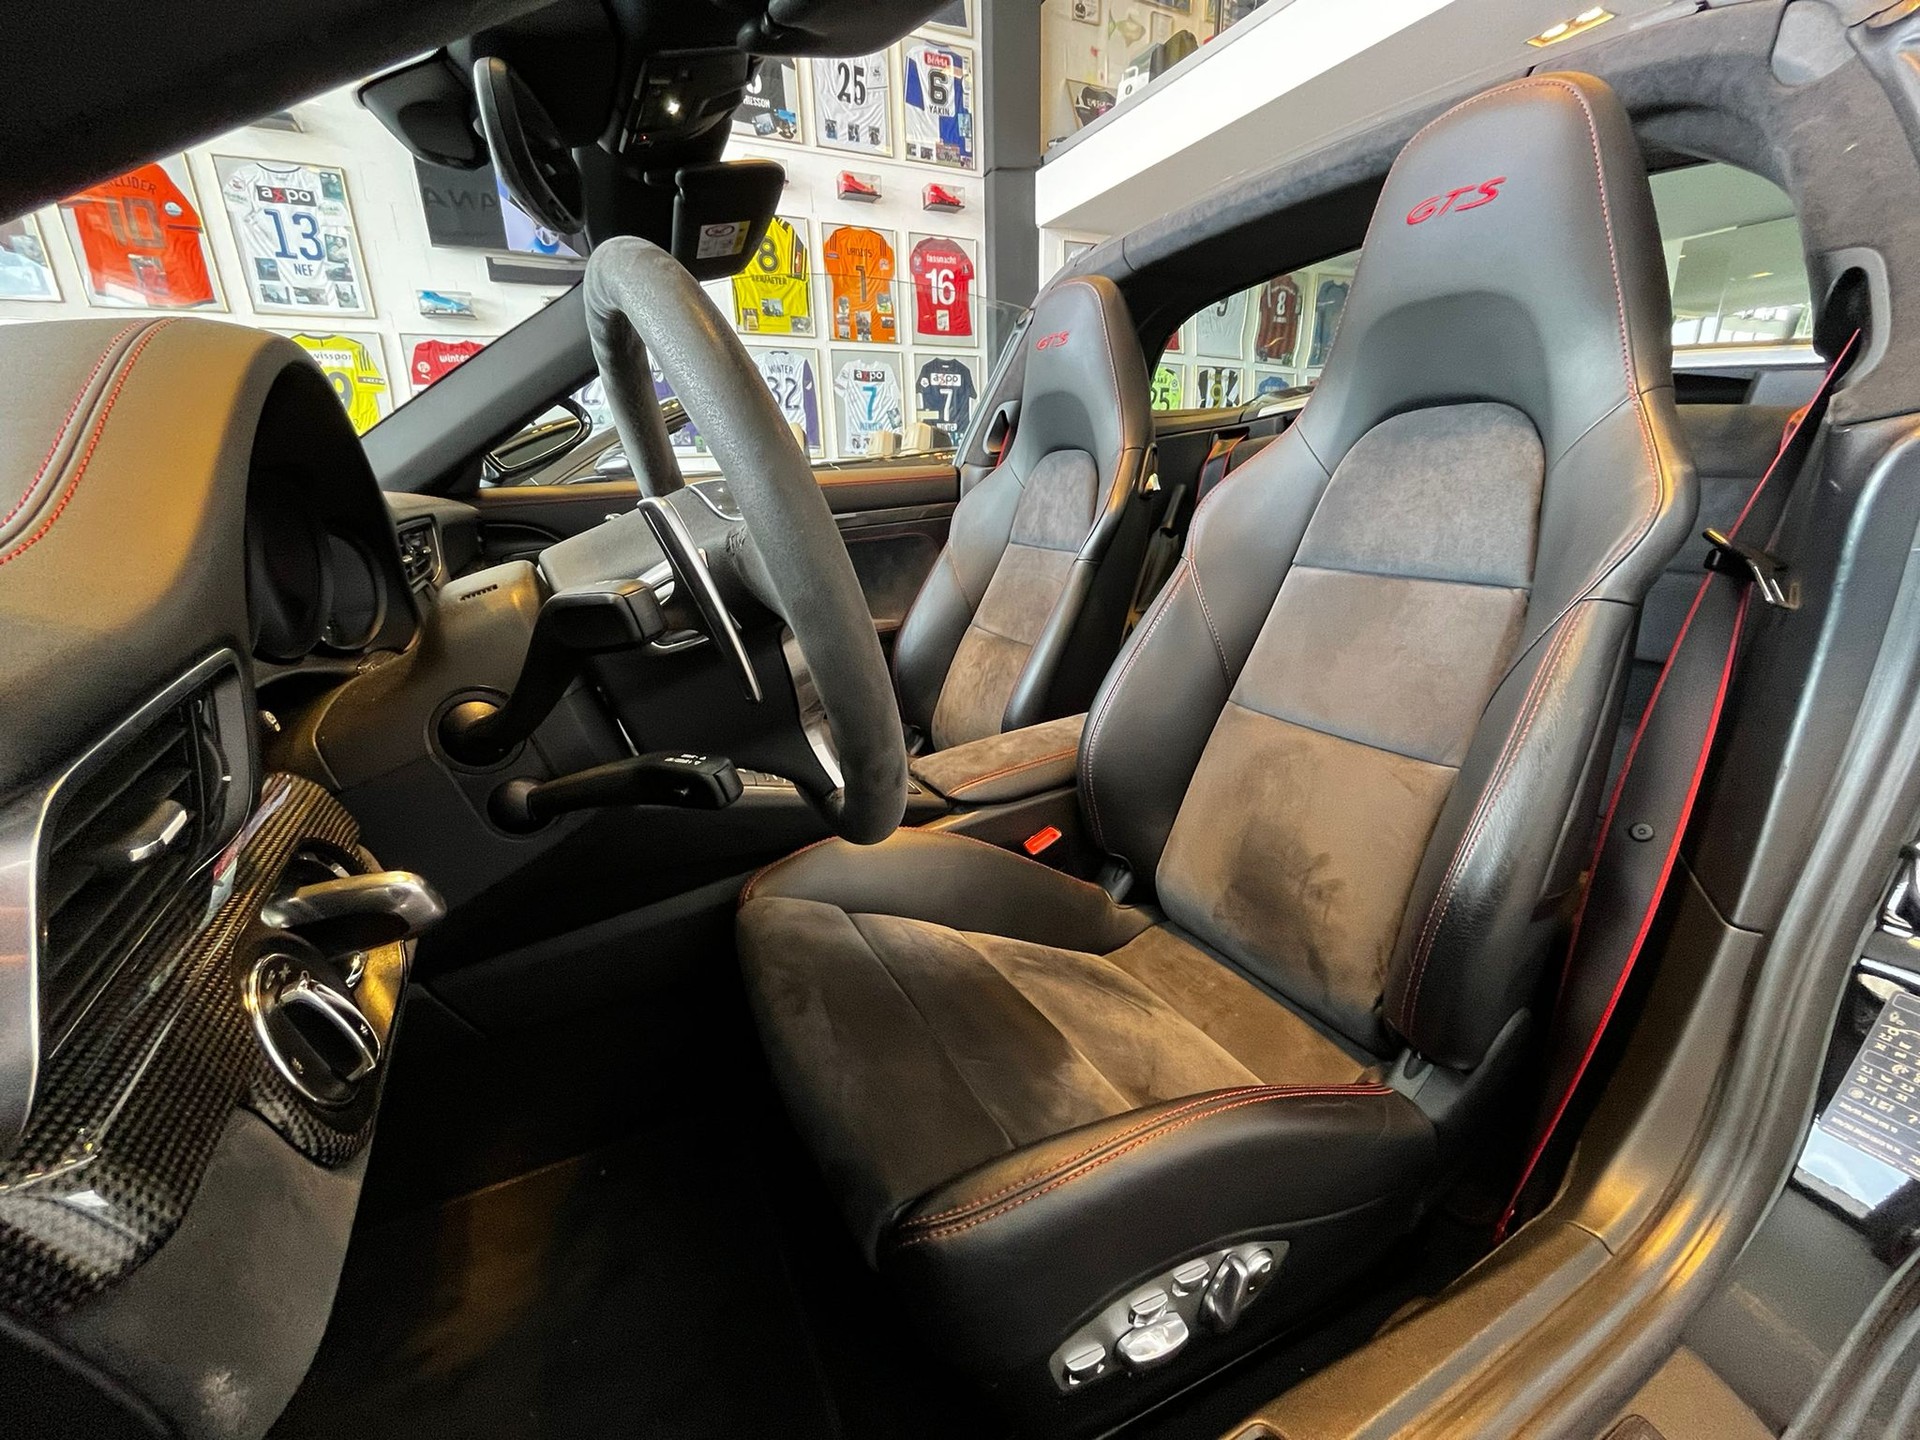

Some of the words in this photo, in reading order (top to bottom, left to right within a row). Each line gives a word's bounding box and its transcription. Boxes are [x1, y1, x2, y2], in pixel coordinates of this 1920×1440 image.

[837, 61, 866, 106] 25
[929, 69, 948, 105] 6
[928, 104, 950, 116] YAKIN
[261, 187, 311, 204] axpo
[1406, 175, 1508, 226] GTS
[105, 195, 167, 249] 10
[263, 208, 325, 261] 13
[293, 263, 314, 276] NEF
[926, 268, 956, 306] 16
[1276, 291, 1287, 315] 8
[1036, 330, 1070, 351] GTS
[767, 375, 800, 410] 32
[862, 385, 877, 421] 7
[940, 388, 954, 421] 7
